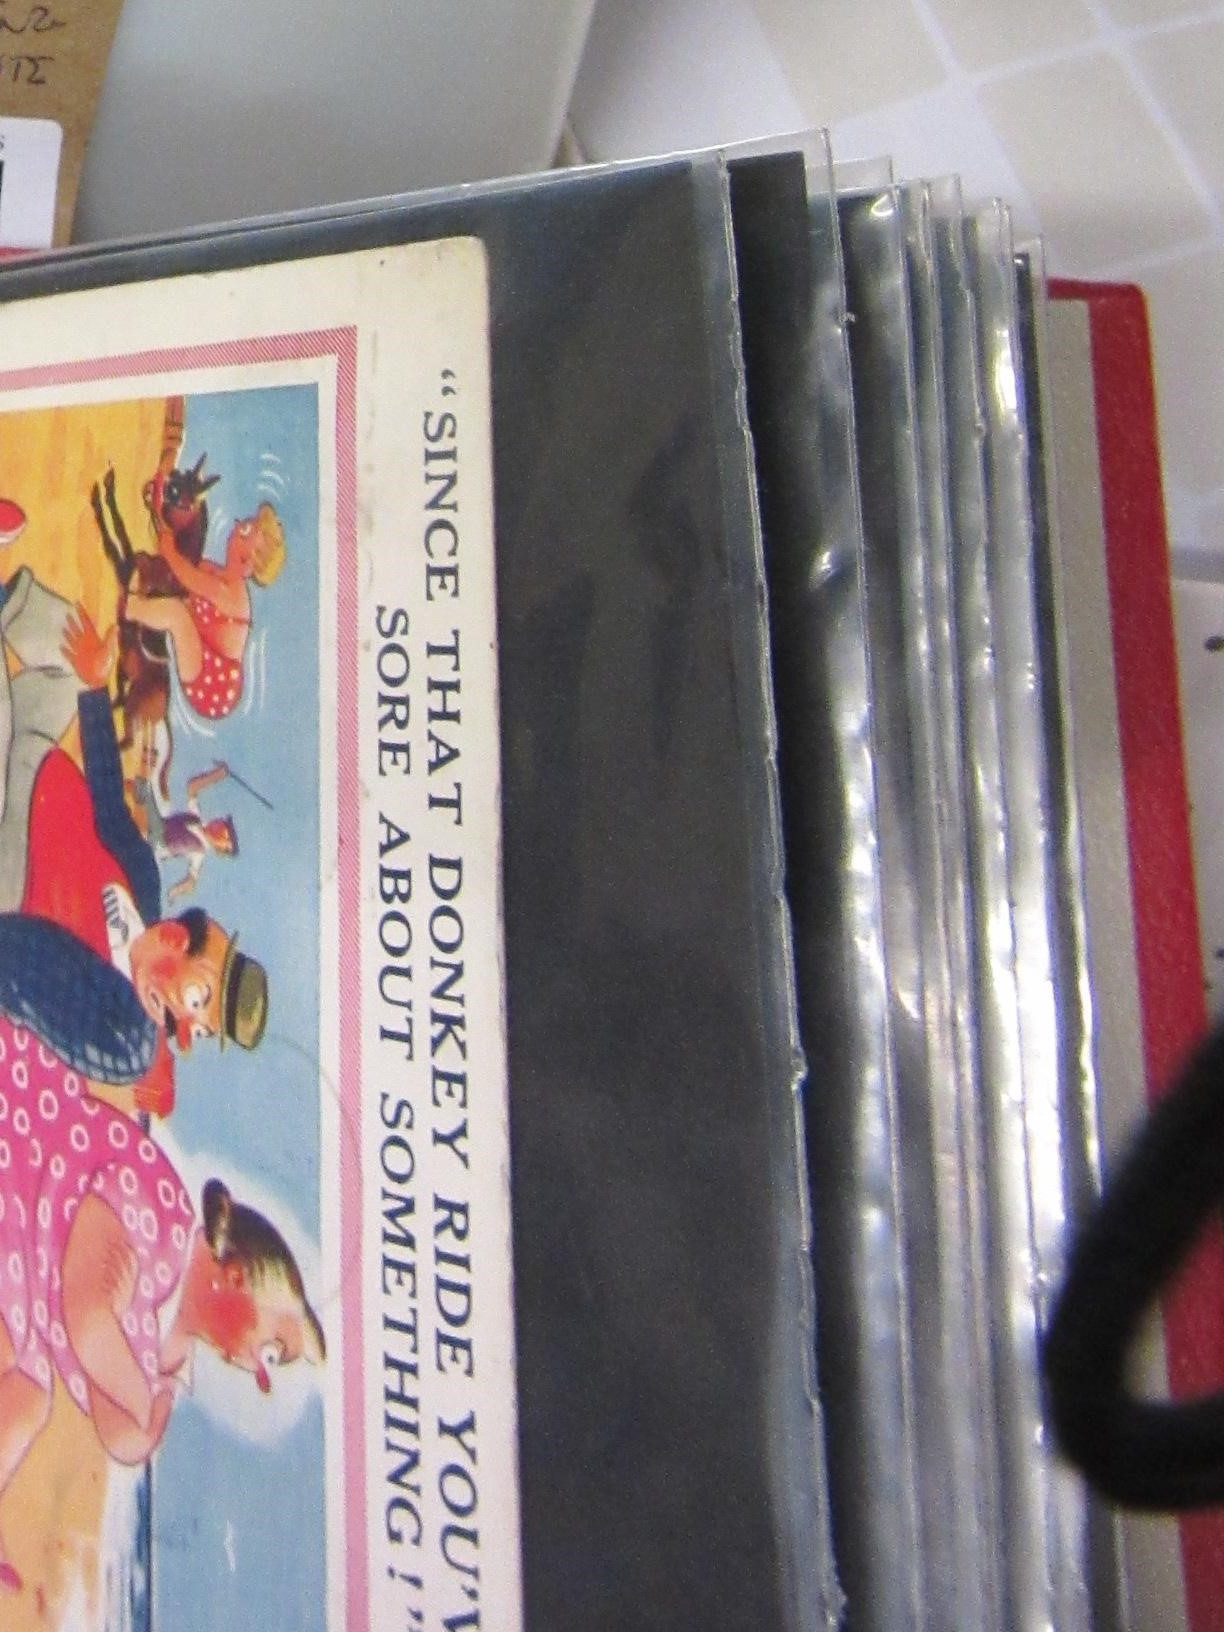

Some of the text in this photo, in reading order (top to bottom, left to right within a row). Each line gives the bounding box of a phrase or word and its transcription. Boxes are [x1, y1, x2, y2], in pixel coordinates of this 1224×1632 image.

[376, 605, 412, 778] SORE
[426, 629, 463, 826] THAT
[378, 811, 415, 1062] ABOUT
[428, 853, 469, 1170] DONKEY
[433, 1192, 475, 1378] RIDE
